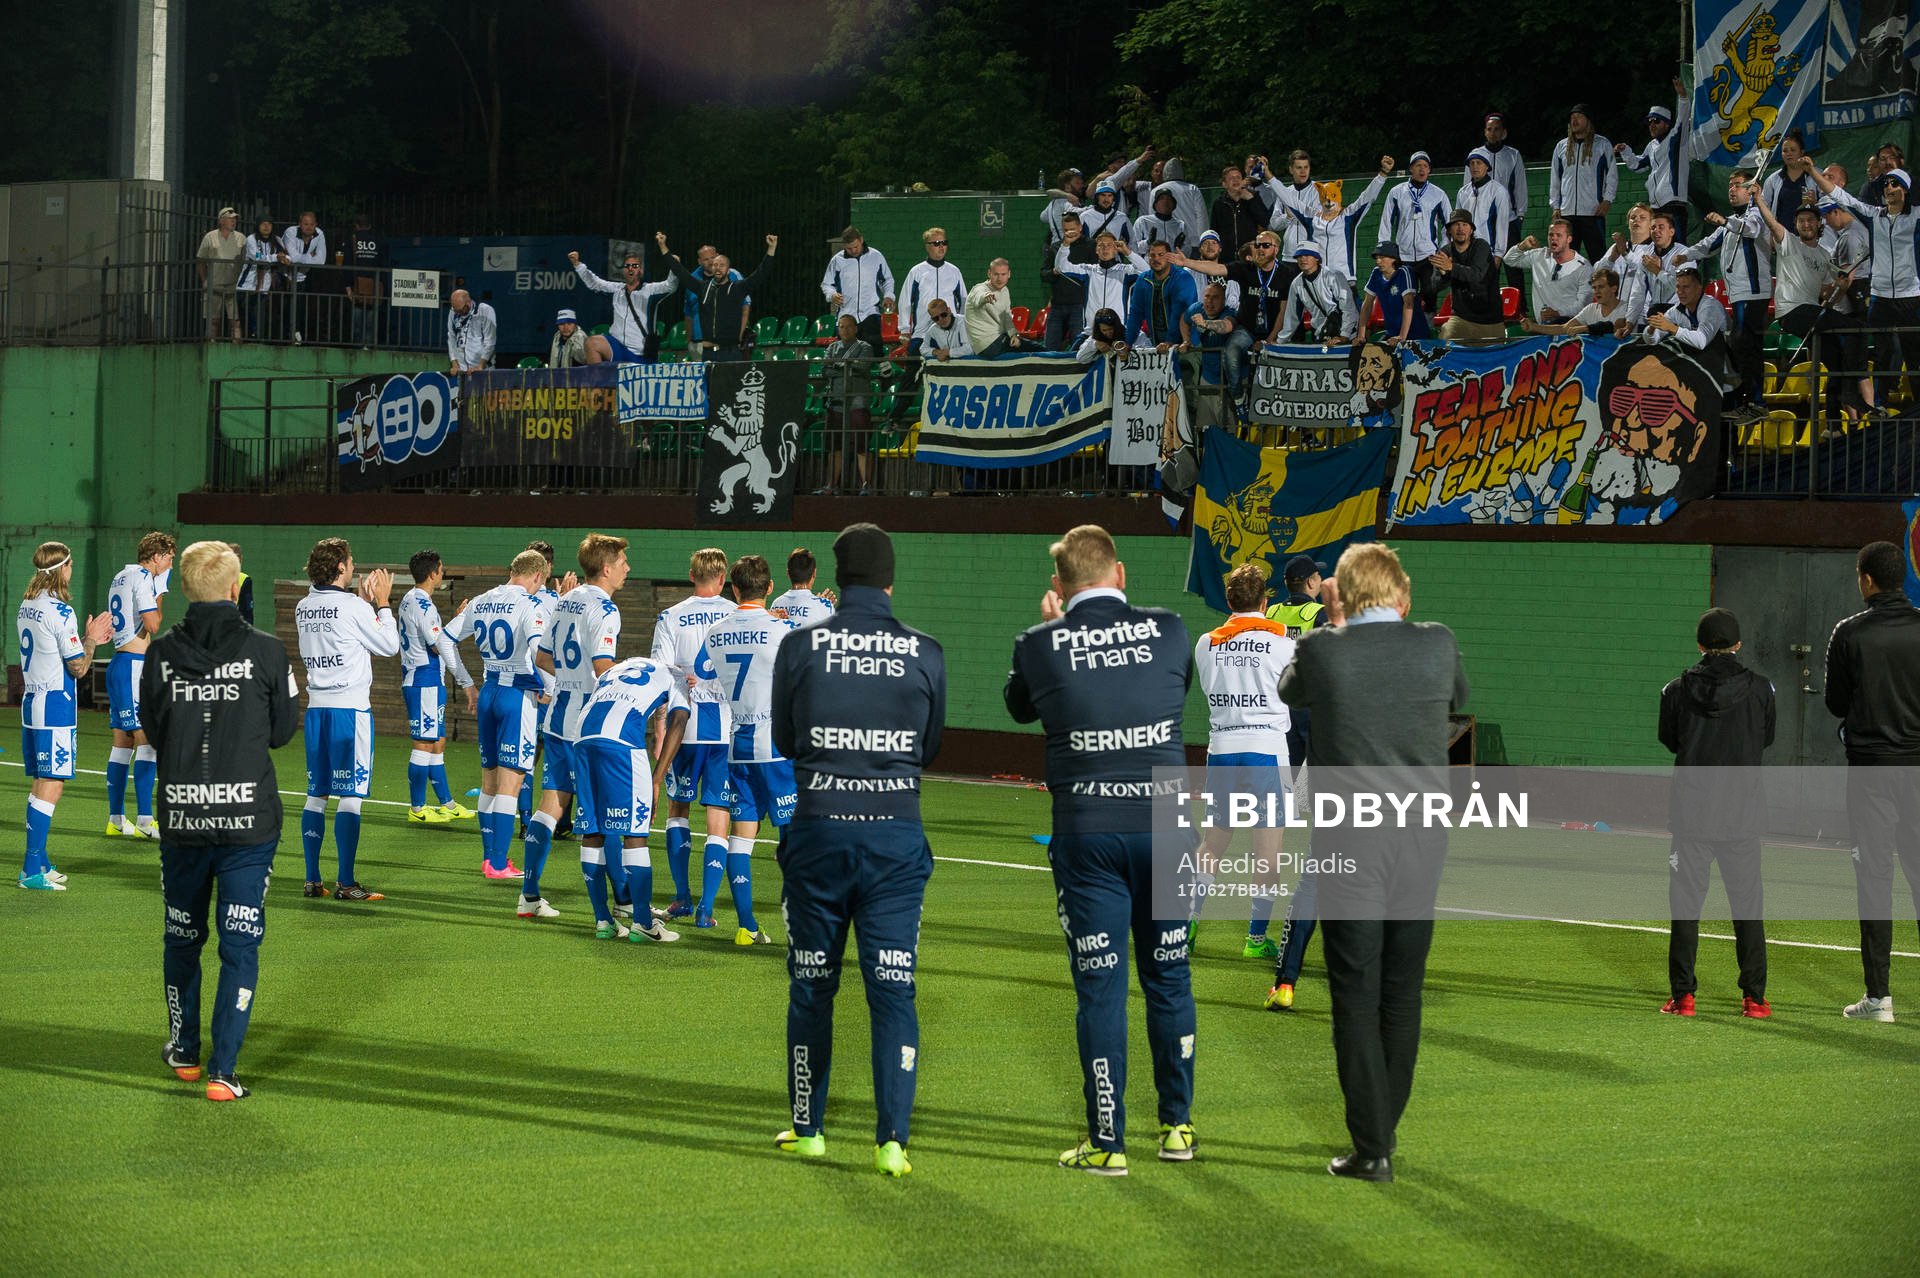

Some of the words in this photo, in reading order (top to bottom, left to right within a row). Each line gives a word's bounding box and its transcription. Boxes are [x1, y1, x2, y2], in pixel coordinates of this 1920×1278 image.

[357, 240, 376, 251] SLO
[394, 279, 418, 289] STADIUM
[534, 270, 577, 291] SDMO
[1258, 365, 1353, 392] ULTRAS
[1411, 369, 1506, 436] FEAR
[1508, 338, 1583, 406] AND
[485, 388, 549, 413] URBAN
[554, 386, 618, 412] BEACH
[618, 378, 706, 410] NUTTERS
[1254, 395, 1351, 420] GÖTEBORG
[525, 417, 574, 440] BOYS
[1411, 380, 1582, 474] LOATHING
[1395, 469, 1437, 517] IN
[1437, 421, 1587, 504] EUROPE
[110, 594, 125, 632] 8
[474, 602, 515, 614] SERNEKE
[299, 620, 332, 633] Finans
[1051, 618, 1161, 652] Prioritet
[20, 628, 34, 672] 9
[473, 619, 515, 661] 20
[551, 620, 582, 670] 16
[709, 631, 768, 648] SERNEKE
[811, 628, 919, 658] Prioritet
[825, 650, 905, 677] Finans
[1069, 644, 1153, 671] Finans
[1216, 652, 1260, 668] Finans
[725, 653, 754, 702] 7
[172, 680, 240, 702] Finans
[1209, 694, 1268, 707] SERNEKE
[810, 726, 917, 752] SERNEKE
[1070, 720, 1175, 752] SERNEKE
[501, 744, 516, 753] NRC
[333, 769, 352, 779] NRC
[836, 777, 916, 792] KONTAKT
[165, 783, 255, 804] SERNEKE
[332, 781, 355, 791] Group
[1100, 778, 1183, 797] KONTAKT
[776, 793, 799, 807] NRC
[186, 816, 256, 830] KONTAKT
[606, 807, 629, 818] NRC
[777, 808, 796, 819] Gro
[604, 820, 631, 831] Group
[168, 906, 191, 924] NRC
[227, 904, 260, 922] NRC
[225, 917, 264, 938] Group
[1161, 925, 1188, 946] NRC
[1076, 931, 1110, 953] NRC
[795, 949, 827, 966] NRC
[879, 949, 912, 968] NRC
[1077, 951, 1119, 972] Group
[794, 964, 834, 979] Group
